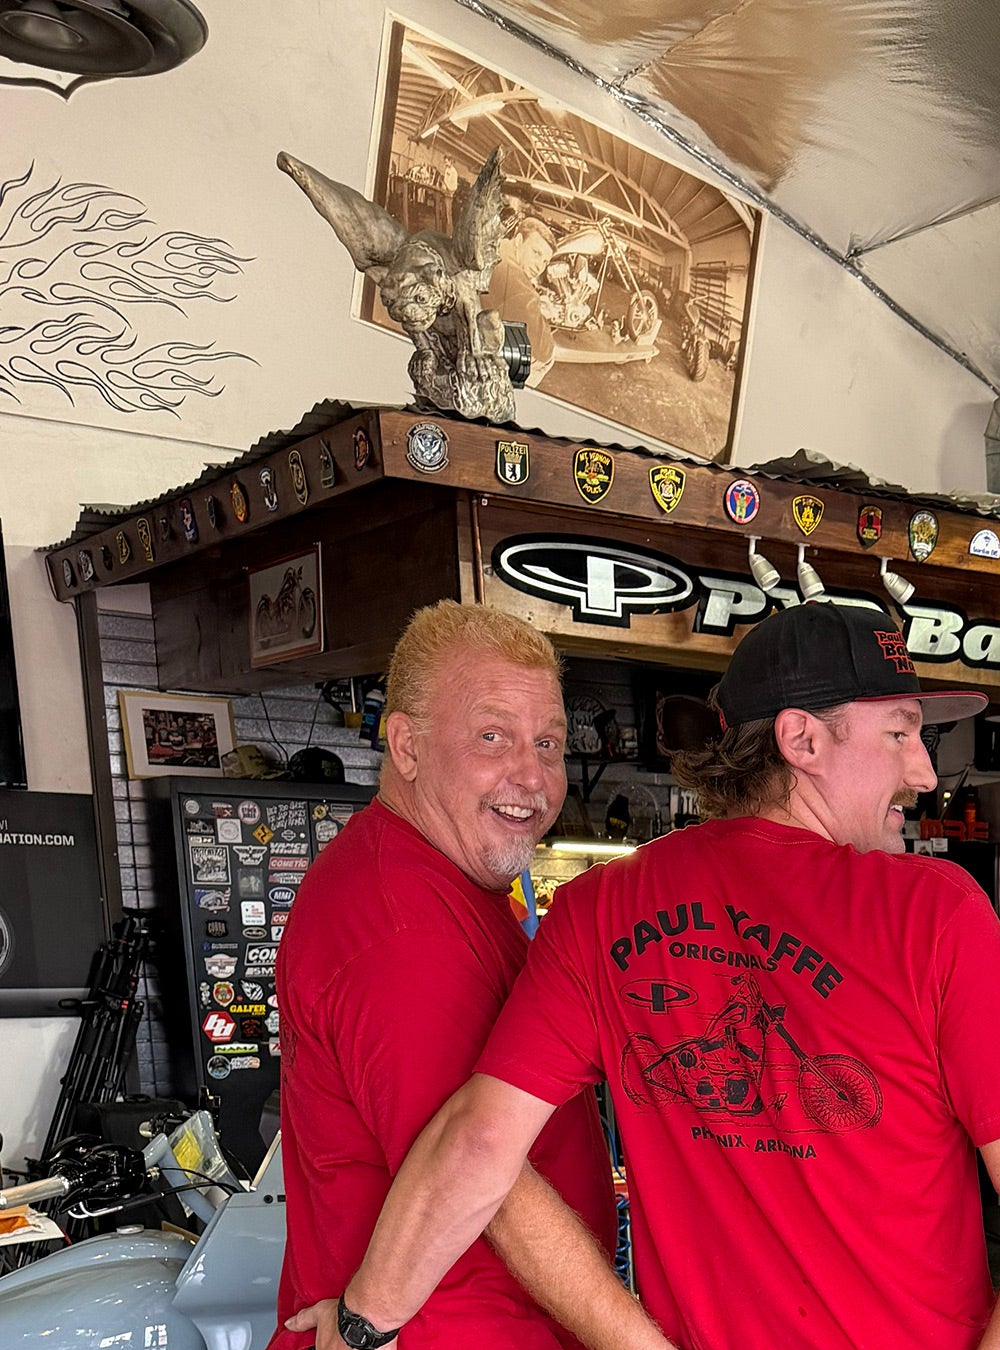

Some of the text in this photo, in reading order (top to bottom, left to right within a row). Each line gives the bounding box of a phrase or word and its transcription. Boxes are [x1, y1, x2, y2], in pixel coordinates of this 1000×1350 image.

[0, 833, 75, 846] ATION.COM
[271, 858, 307, 868] COMETIC
[273, 891, 292, 900] MMI
[609, 902, 715, 972] PAUL
[668, 941, 779, 973] ORIGINALS
[725, 904, 844, 999] YAFFE
[229, 1004, 266, 1013] GALFER
